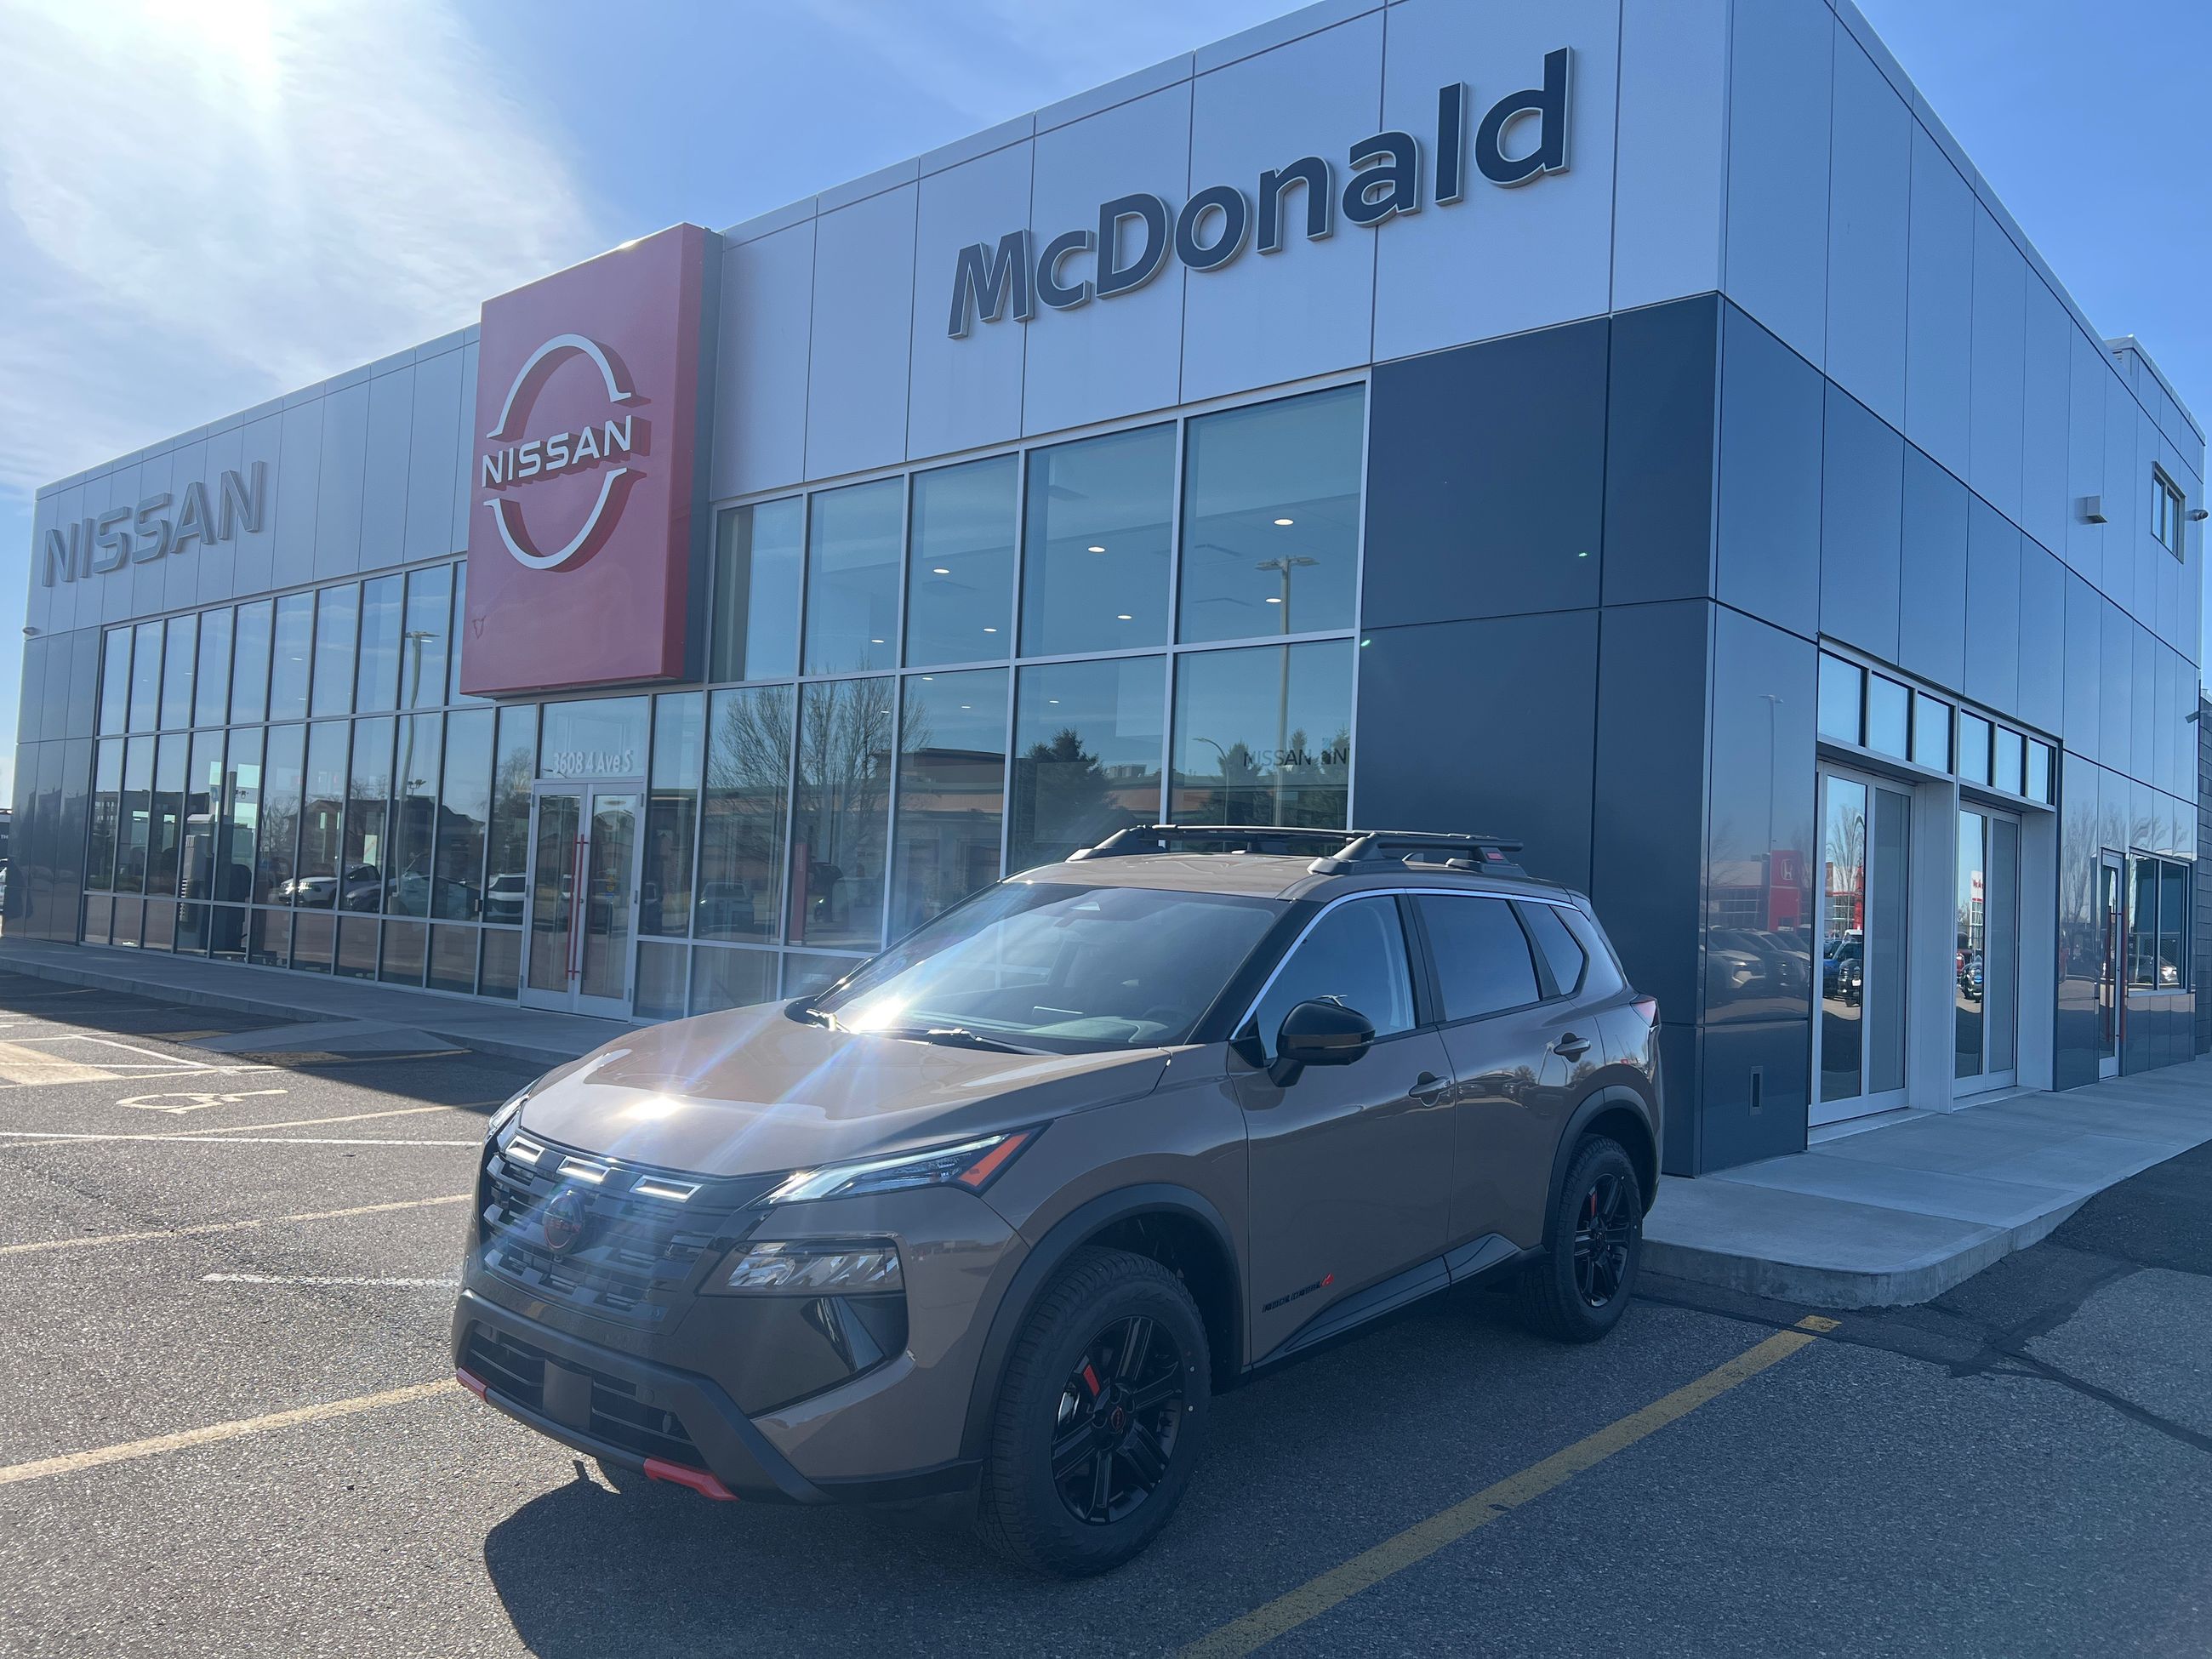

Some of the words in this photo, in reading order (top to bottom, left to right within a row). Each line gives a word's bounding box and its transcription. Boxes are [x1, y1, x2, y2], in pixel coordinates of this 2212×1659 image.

[947, 45, 1574, 339] McDonald
[482, 414, 633, 487] NISSAN
[42, 460, 265, 587] NISSAN
[552, 752, 584, 774] 3608
[585, 751, 595, 772] 4
[596, 750, 621, 773] Ave
[623, 749, 633, 773] S
[1243, 749, 1312, 767] NISSAN
